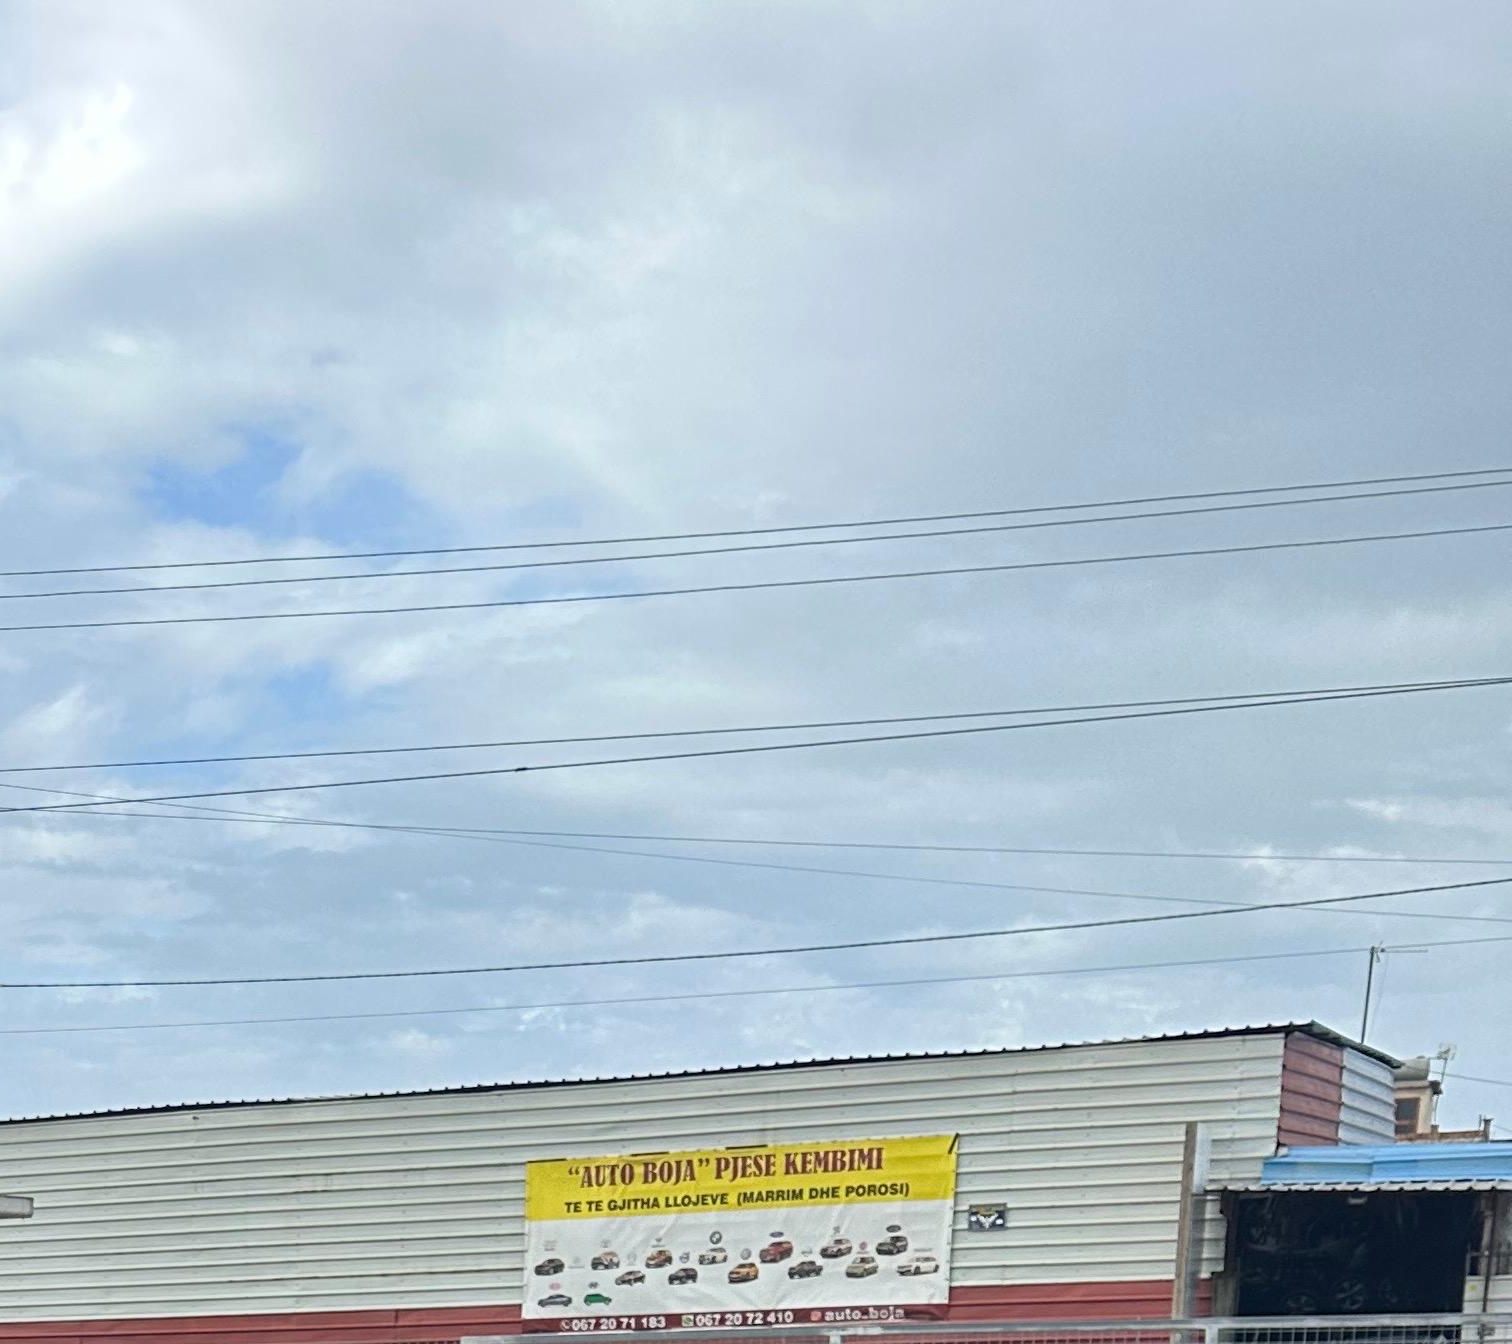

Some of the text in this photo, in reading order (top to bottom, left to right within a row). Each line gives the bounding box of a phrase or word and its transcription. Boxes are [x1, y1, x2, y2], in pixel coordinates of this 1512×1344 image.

[715, 1154, 776, 1182] PJESE
[784, 1147, 885, 1175] KEMBIMI
[564, 1182, 910, 1213] TE TE GJITHA LLOJEVE (MARRIM DHE POROSI)
[571, 1315, 666, 1331] 067 20 71 183
[695, 1310, 794, 1327] 067 20 72 410
